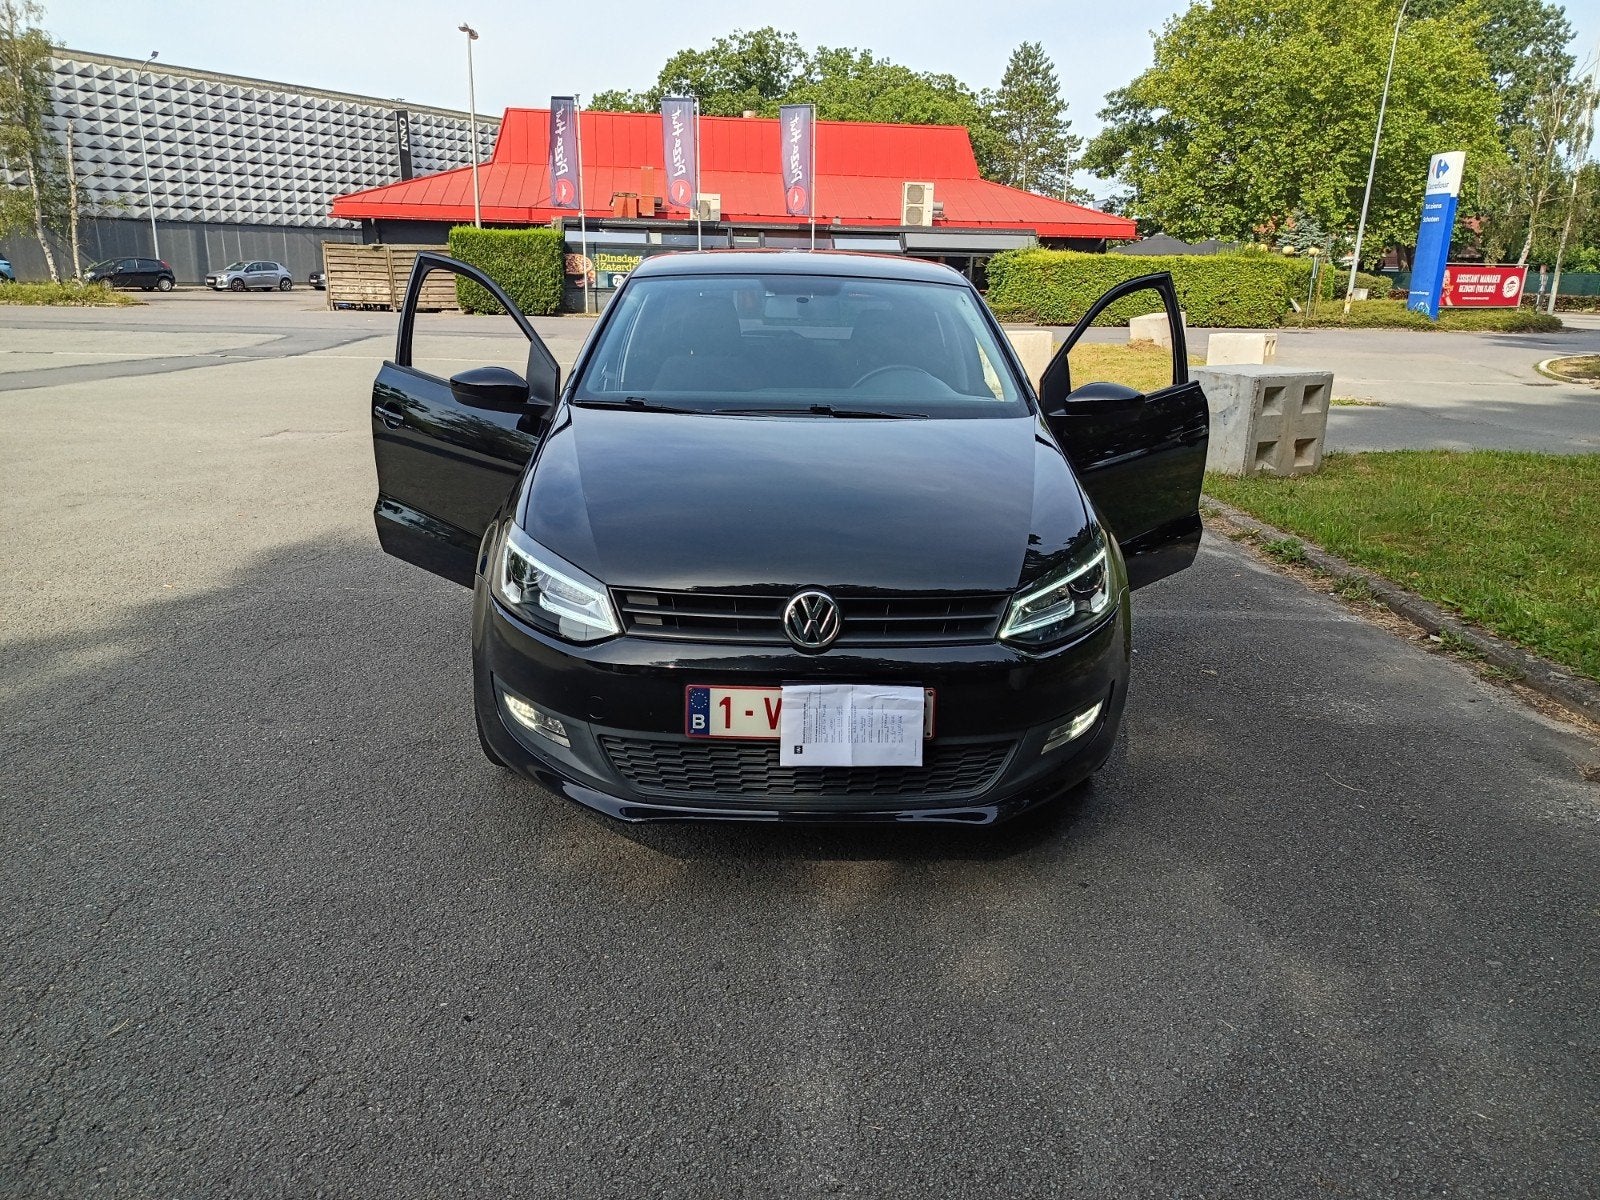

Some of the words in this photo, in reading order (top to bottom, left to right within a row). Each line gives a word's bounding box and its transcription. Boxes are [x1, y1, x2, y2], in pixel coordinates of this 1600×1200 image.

[399, 118, 408, 151] INNO
[599, 253, 639, 265] Dinsdag
[692, 713, 706, 729] B
